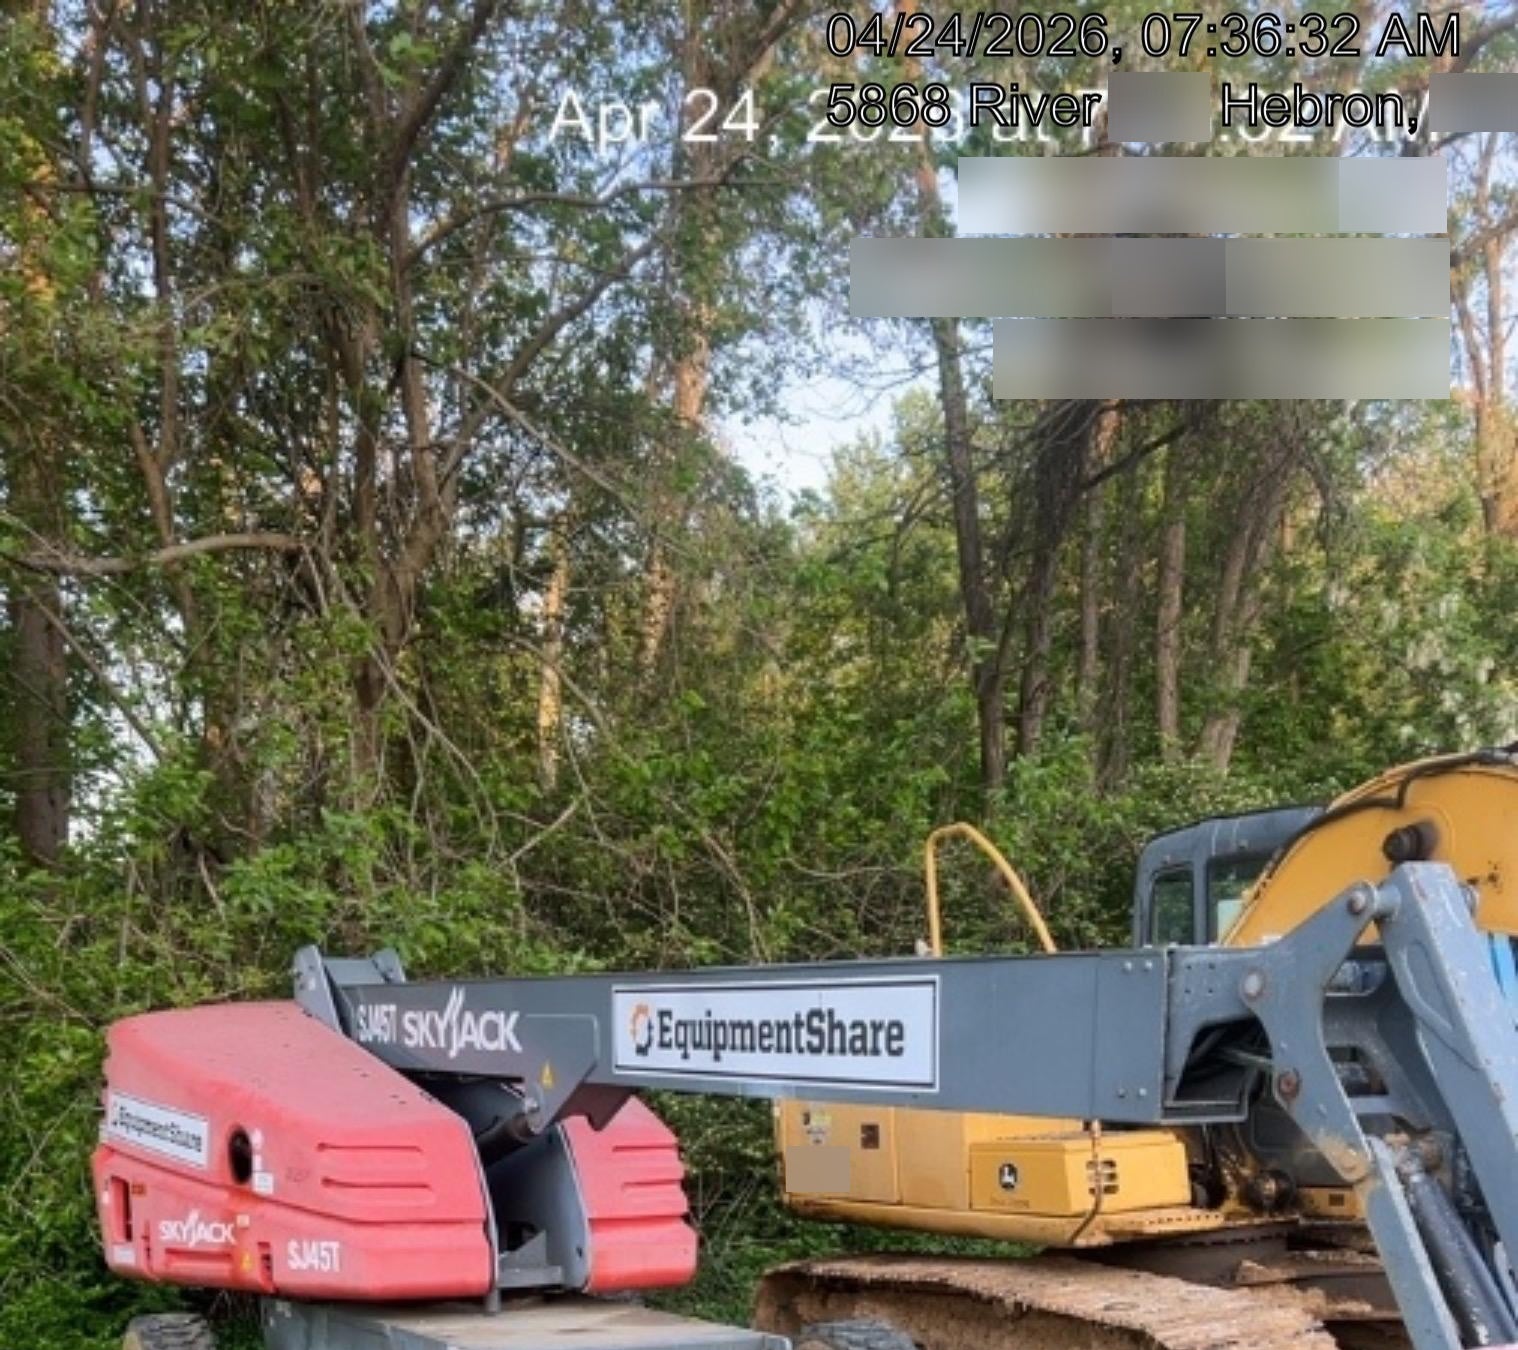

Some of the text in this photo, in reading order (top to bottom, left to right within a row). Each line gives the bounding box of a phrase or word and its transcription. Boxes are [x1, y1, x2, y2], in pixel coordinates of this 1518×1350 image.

[358, 984, 523, 1059] SJ45T SKYJACK
[656, 1008, 905, 1061] EquipmentShare
[159, 1209, 236, 1248] SKYJACK
[287, 1240, 340, 1272] SJ45T
